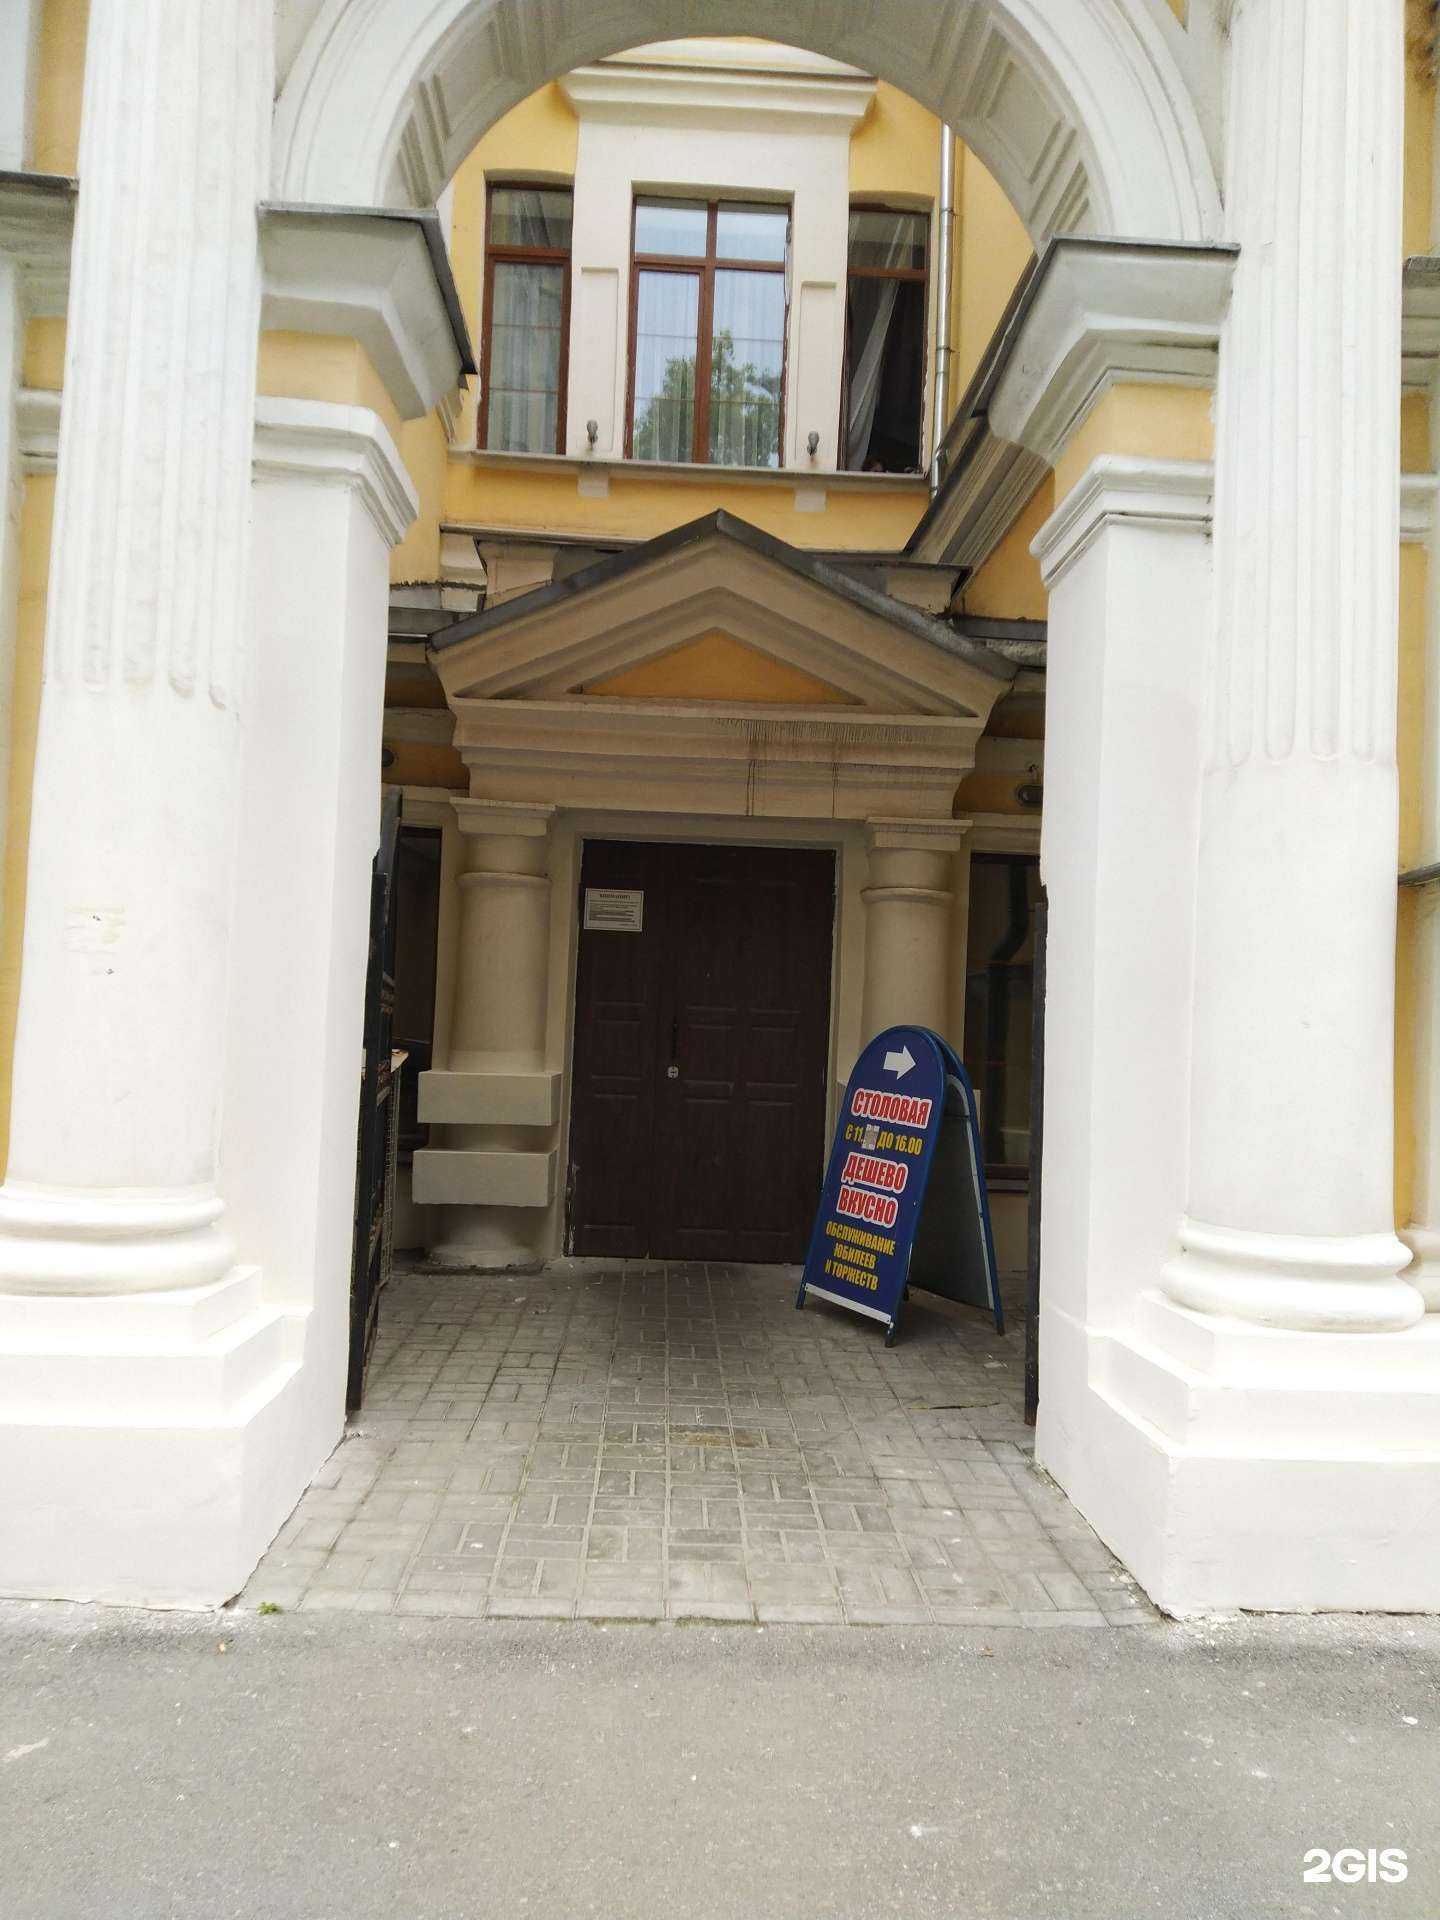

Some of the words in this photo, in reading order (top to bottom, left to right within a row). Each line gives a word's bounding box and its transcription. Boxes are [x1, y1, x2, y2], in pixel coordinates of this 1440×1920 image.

[852, 1089, 931, 1128] СТОЛОВАЯ
[845, 1123, 855, 1140] С
[877, 1131, 894, 1150] ДО
[894, 1134, 923, 1156] 16.00
[842, 1154, 907, 1192] ДЕШЕВО
[837, 1186, 897, 1226] ВКУСНО
[825, 1221, 896, 1256] ОБСЛУЖИВАНИЕ
[833, 1242, 877, 1270] ЮБИЛЕЕВ
[824, 1259, 832, 1274] И
[831, 1261, 879, 1291] ТОРЖЕСТВ
